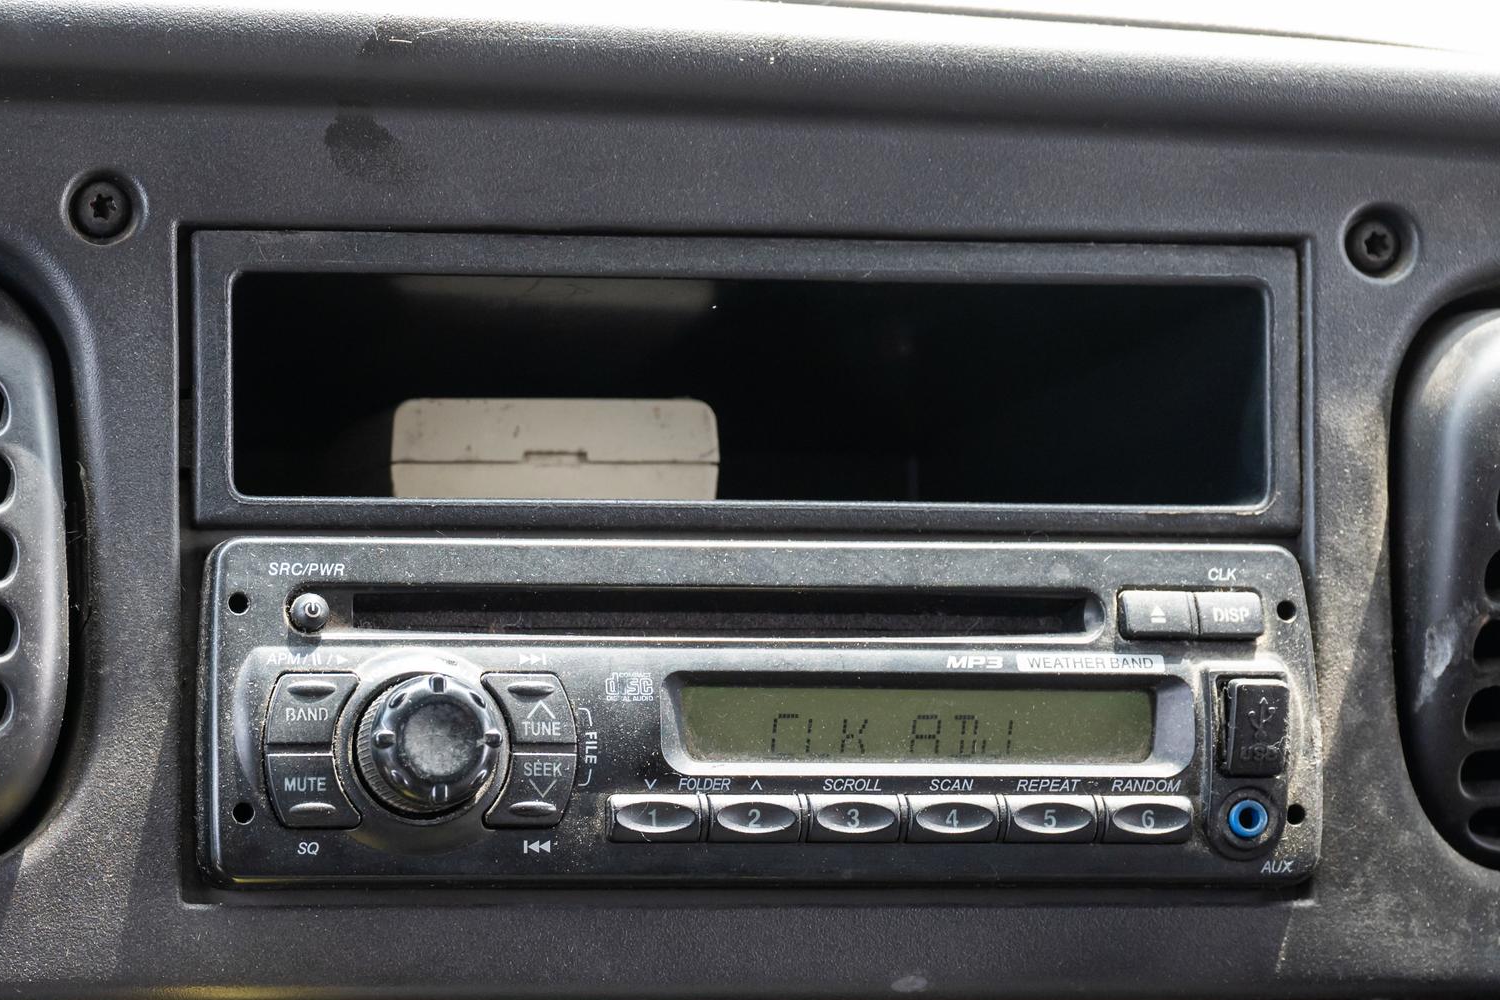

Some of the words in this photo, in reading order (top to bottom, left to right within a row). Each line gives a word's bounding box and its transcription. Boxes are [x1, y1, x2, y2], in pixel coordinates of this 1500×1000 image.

[268, 562, 346, 576] SRC/PWR
[1208, 567, 1237, 581] CLK
[1212, 607, 1250, 623] DISP
[946, 655, 1004, 669] MP3
[1027, 656, 1106, 669] WEATHER
[1110, 657, 1154, 669] BAND
[286, 707, 329, 722] BAND
[522, 721, 561, 736] TUNE
[584, 731, 598, 764] FILE
[524, 762, 563, 777] SEEK
[284, 777, 327, 792] MUTE
[678, 778, 731, 791] FOLDER
[822, 779, 882, 792] SCROLL
[929, 779, 974, 791] SCAN
[1016, 779, 1081, 792] REPEAT
[1111, 779, 1182, 793] RANDOM
[647, 809, 657, 827] 1
[748, 809, 761, 827] 2
[847, 809, 860, 828] 3
[945, 809, 959, 828] 4
[1043, 809, 1057, 828] 5
[1141, 809, 1155, 829] 6
[297, 842, 320, 855] SQ
[1260, 860, 1295, 875] AUX
